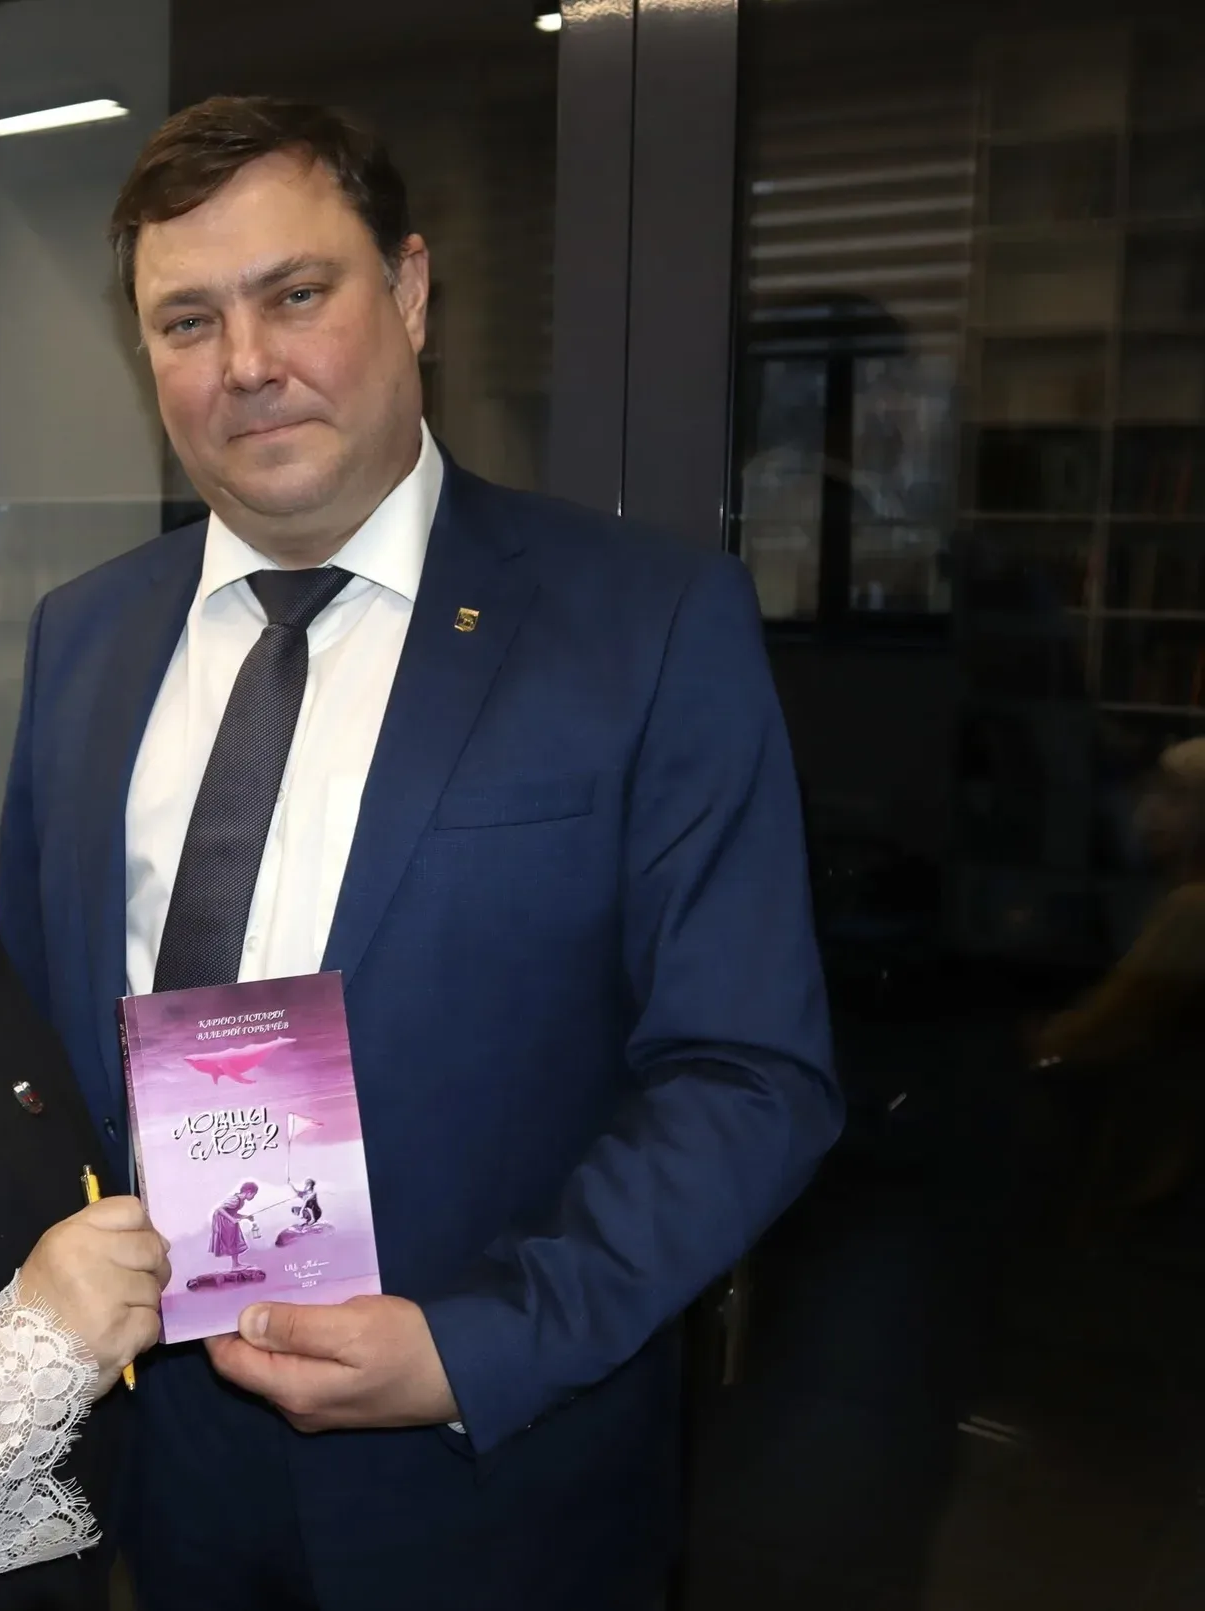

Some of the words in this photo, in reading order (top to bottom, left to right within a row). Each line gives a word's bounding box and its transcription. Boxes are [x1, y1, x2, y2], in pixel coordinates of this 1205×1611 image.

[198, 1016, 236, 1029] КАРИНЭ
[237, 1009, 285, 1024] ГАСПАРЯН
[196, 1026, 241, 1041] ВАЛЕРИЙ
[241, 1021, 289, 1035] ГОРБАЧЁВ
